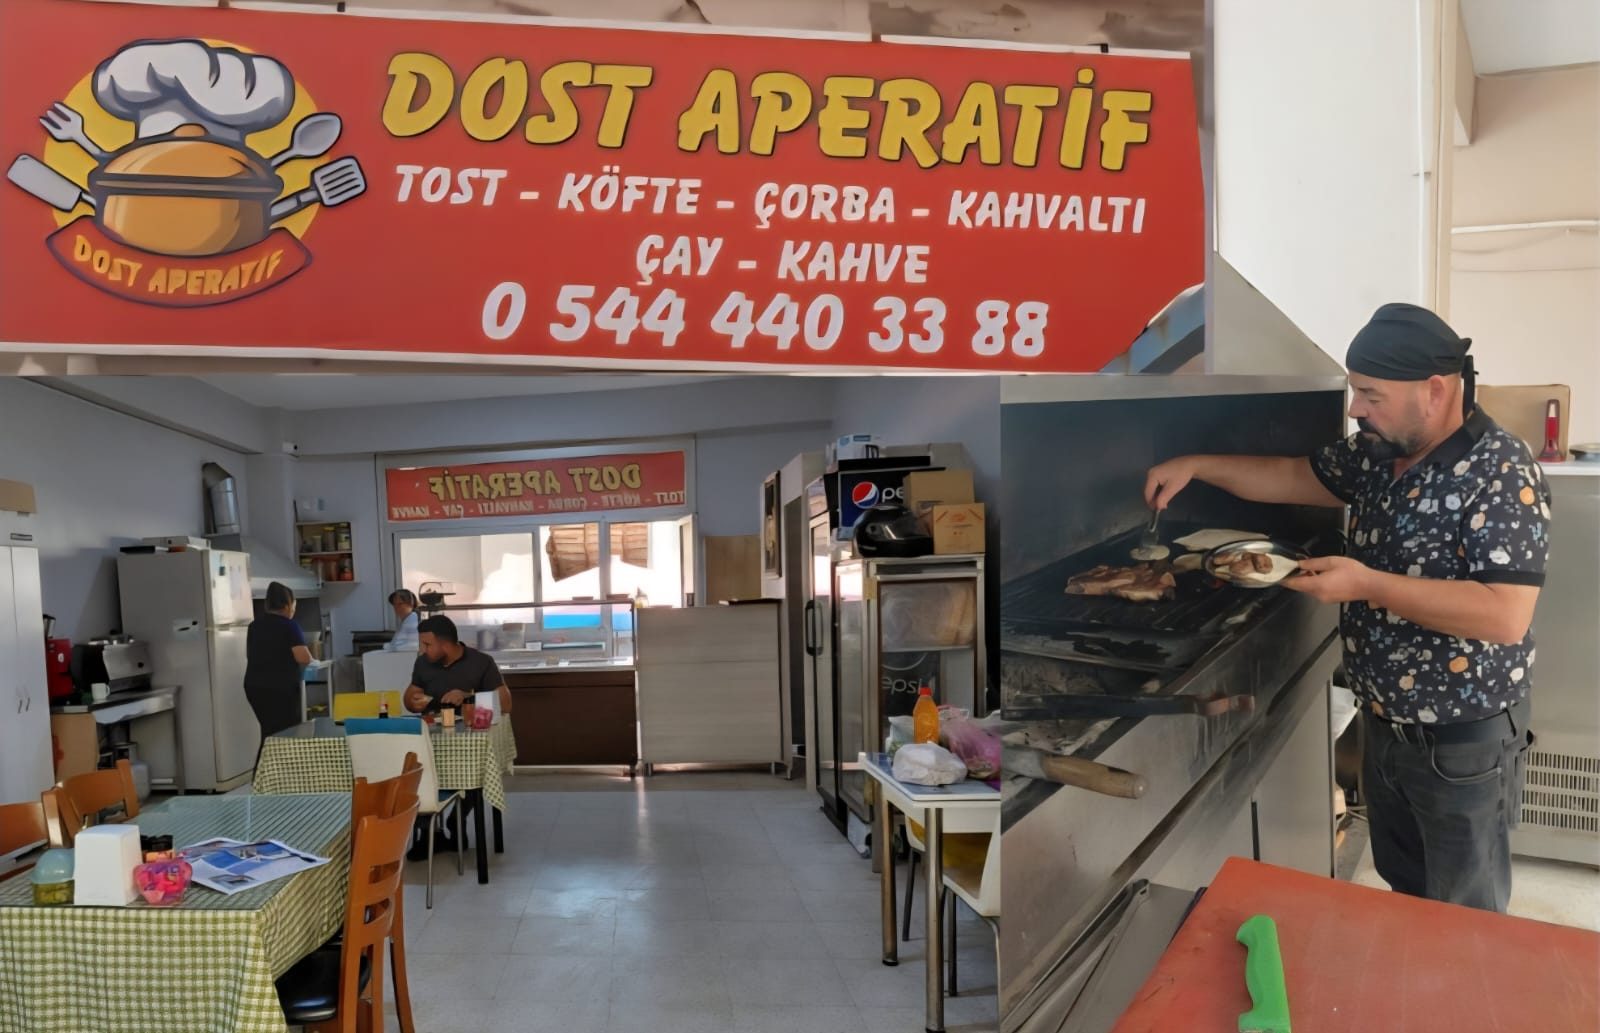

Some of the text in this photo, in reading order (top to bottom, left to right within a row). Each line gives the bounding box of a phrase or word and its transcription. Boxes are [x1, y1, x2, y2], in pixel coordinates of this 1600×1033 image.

[382, 52, 1152, 171] DOST APERATİF
[396, 164, 508, 206] TOST
[557, 165, 702, 215] KÖFTE
[754, 182, 895, 229] ÇORBA
[947, 189, 1146, 234] KAHVALTI
[73, 234, 143, 287] DOST
[636, 234, 724, 286] ÇAY
[777, 239, 930, 283] KAHVE
[481, 281, 1049, 358] 0 544 440 33 88
